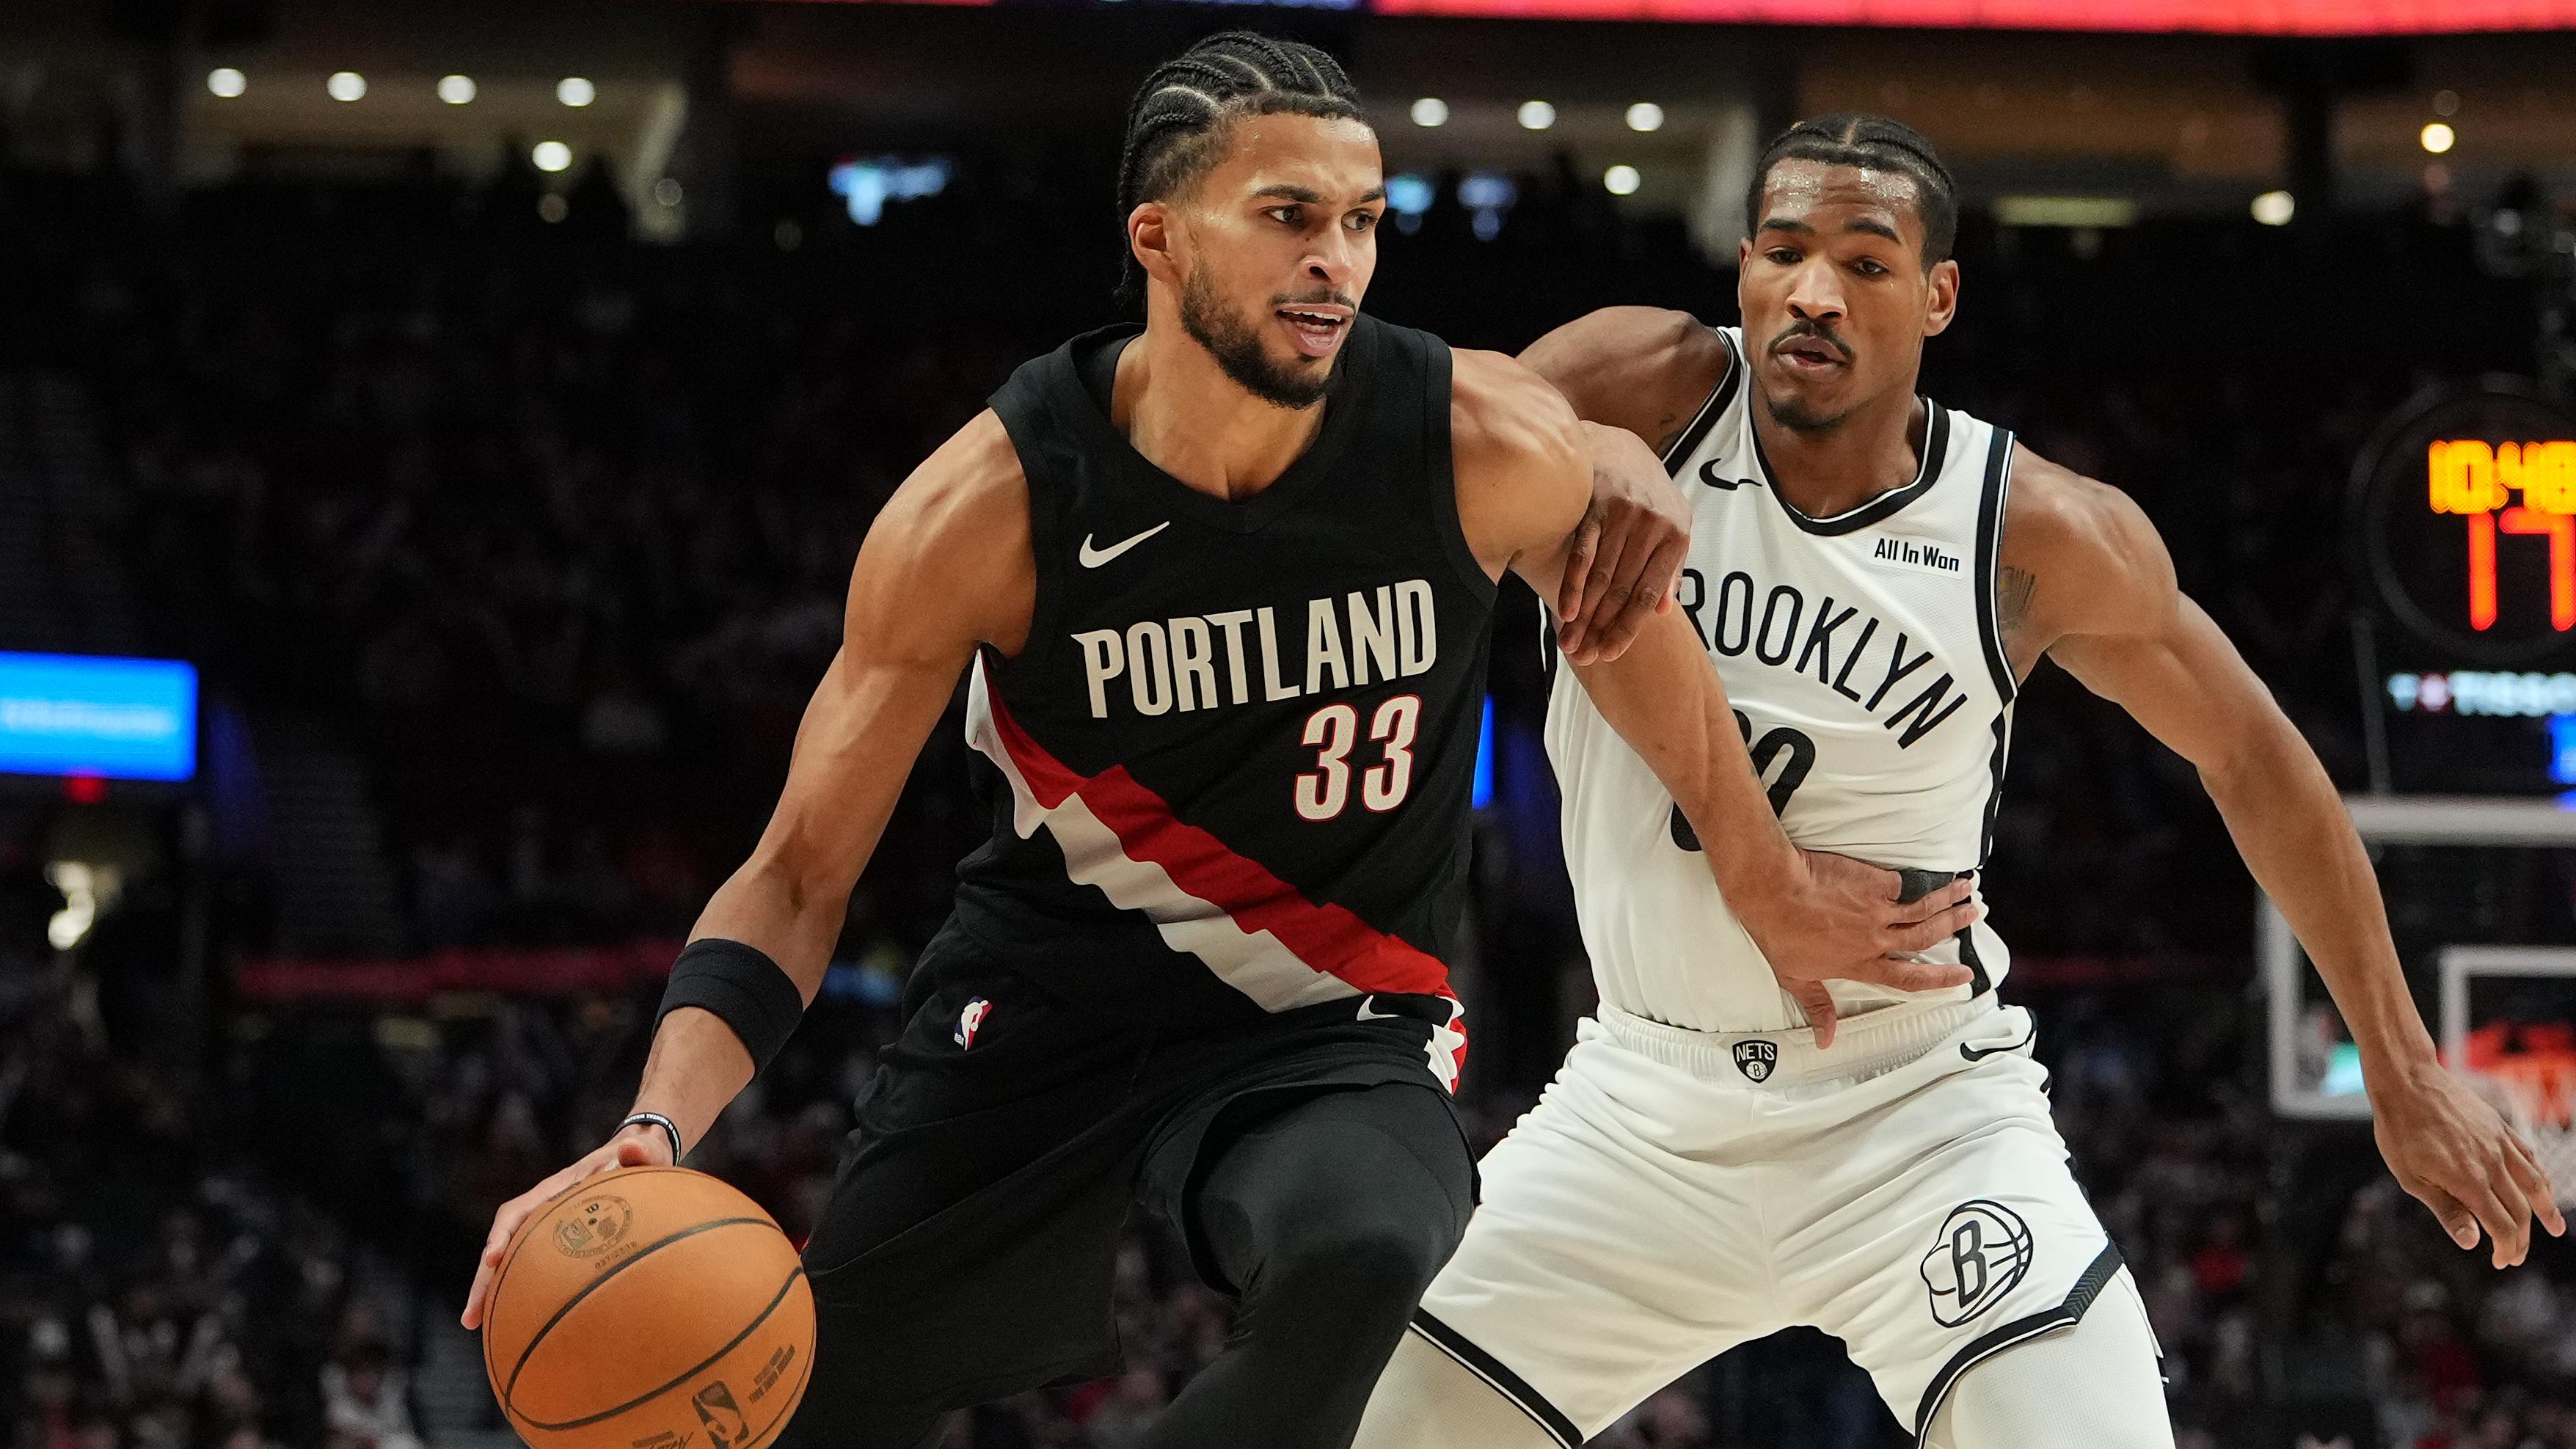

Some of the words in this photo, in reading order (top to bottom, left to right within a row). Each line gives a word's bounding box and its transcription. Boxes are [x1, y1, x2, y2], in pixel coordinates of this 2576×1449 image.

[1874, 538, 1899, 561] All
[1902, 541, 1919, 564] In
[1923, 545, 1960, 572] Won
[2468, 507, 2576, 632] 17
[1070, 579, 1437, 718] PORTLAND
[1676, 568, 1968, 750] ROOKLYN
[1293, 694, 1422, 822] 33
[1735, 1043, 1776, 1063] NETS
[1753, 1063, 1762, 1077] B
[1952, 1219, 1988, 1309] B
